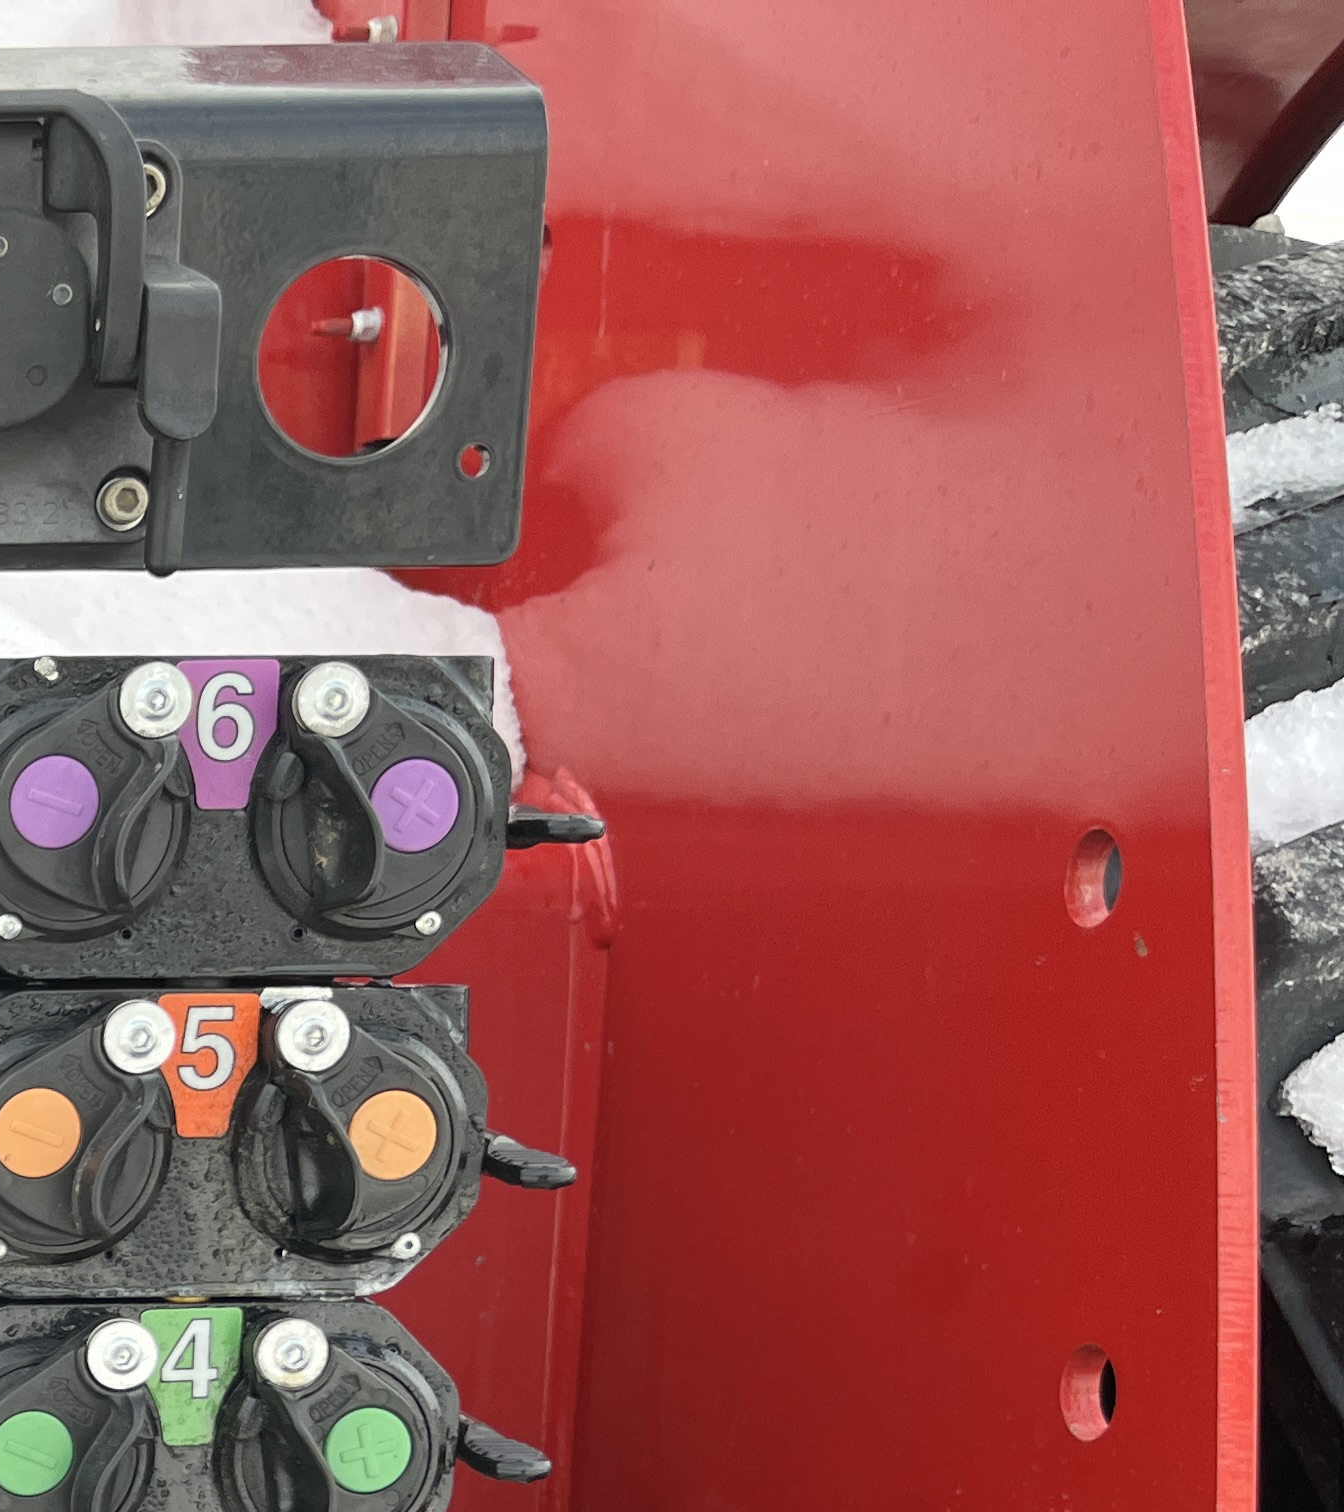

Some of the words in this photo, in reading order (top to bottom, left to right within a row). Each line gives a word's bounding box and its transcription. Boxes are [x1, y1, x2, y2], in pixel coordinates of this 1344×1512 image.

[196, 673, 254, 761] 6
[351, 733, 397, 776] OPEN
[177, 1006, 237, 1090] 5
[331, 1066, 373, 1109] OPEN
[160, 1318, 218, 1399] 4
